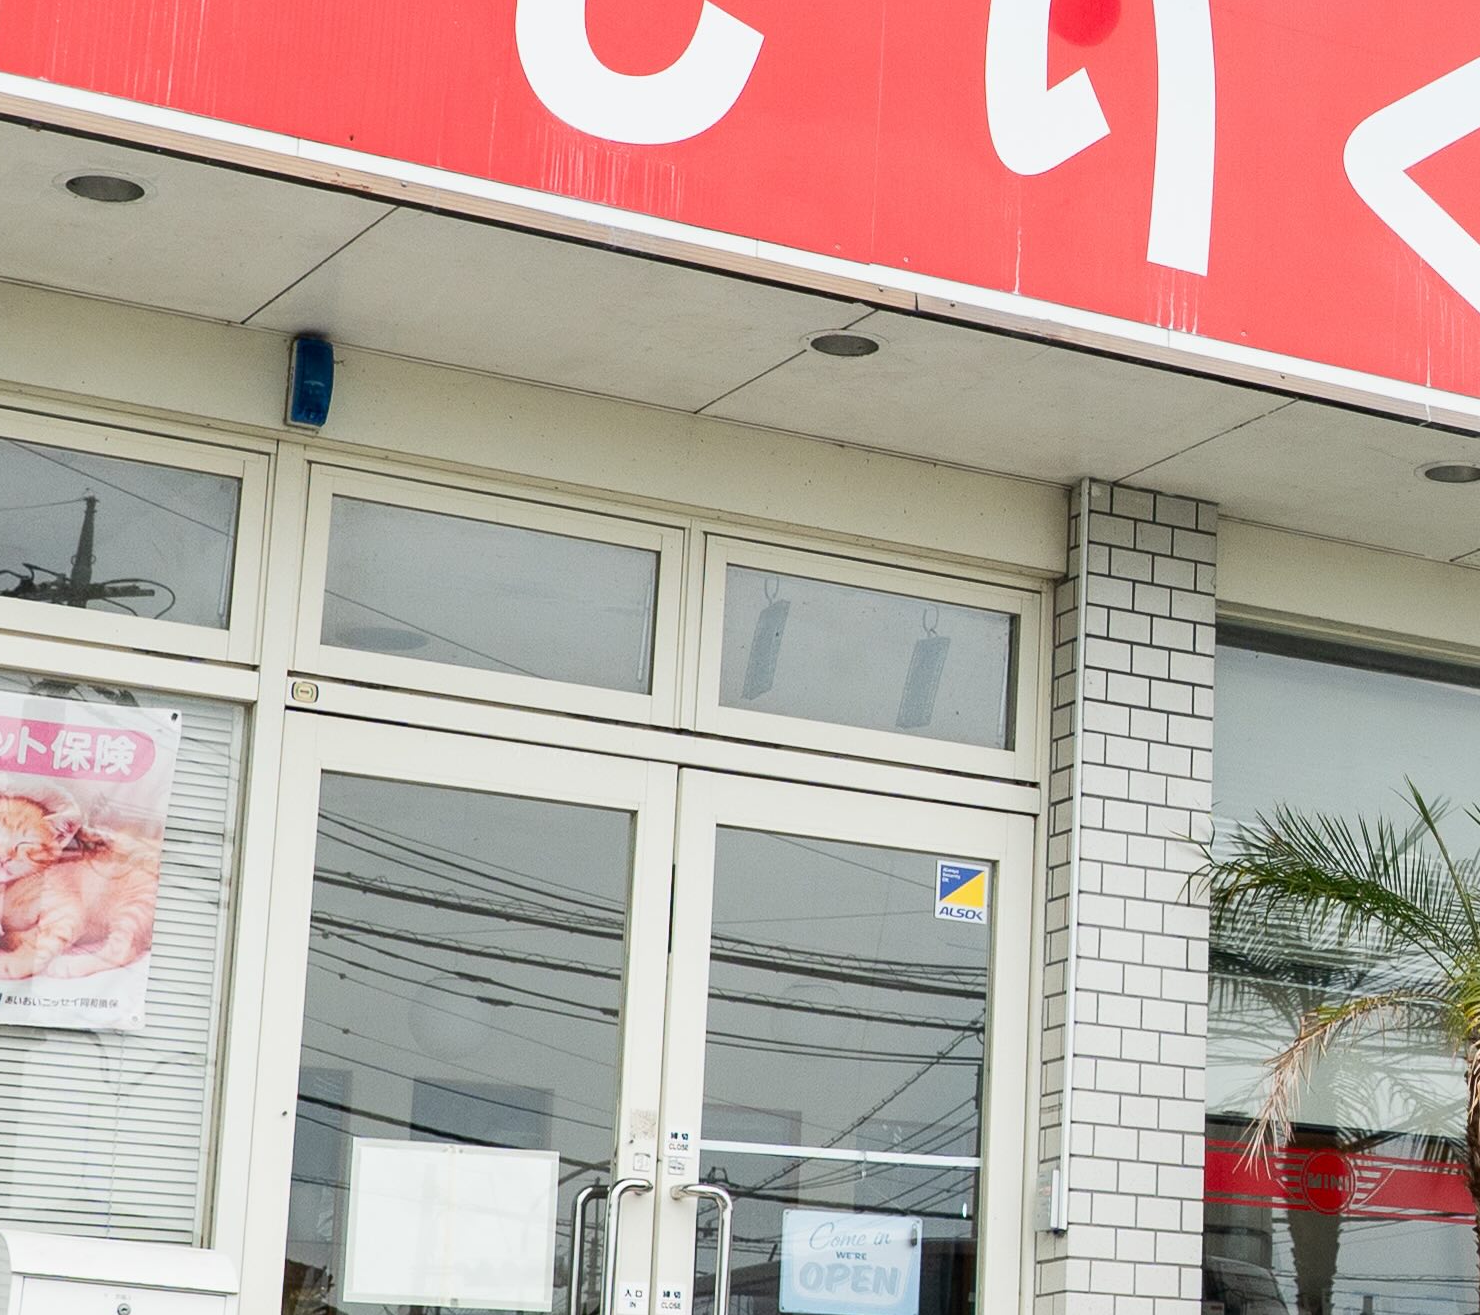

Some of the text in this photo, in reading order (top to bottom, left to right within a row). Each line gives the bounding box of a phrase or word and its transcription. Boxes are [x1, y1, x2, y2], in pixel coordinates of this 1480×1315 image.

[939, 906, 983, 921] ALSOK
[668, 1143, 689, 1151] CLOSE
[1307, 1172, 1350, 1192] MINI
[809, 1222, 891, 1251] Come in
[800, 1262, 899, 1296] OPEN
[624, 1289, 643, 1298] 入口
[629, 1301, 637, 1309] IN
[661, 1301, 681, 1310] CLOSE
